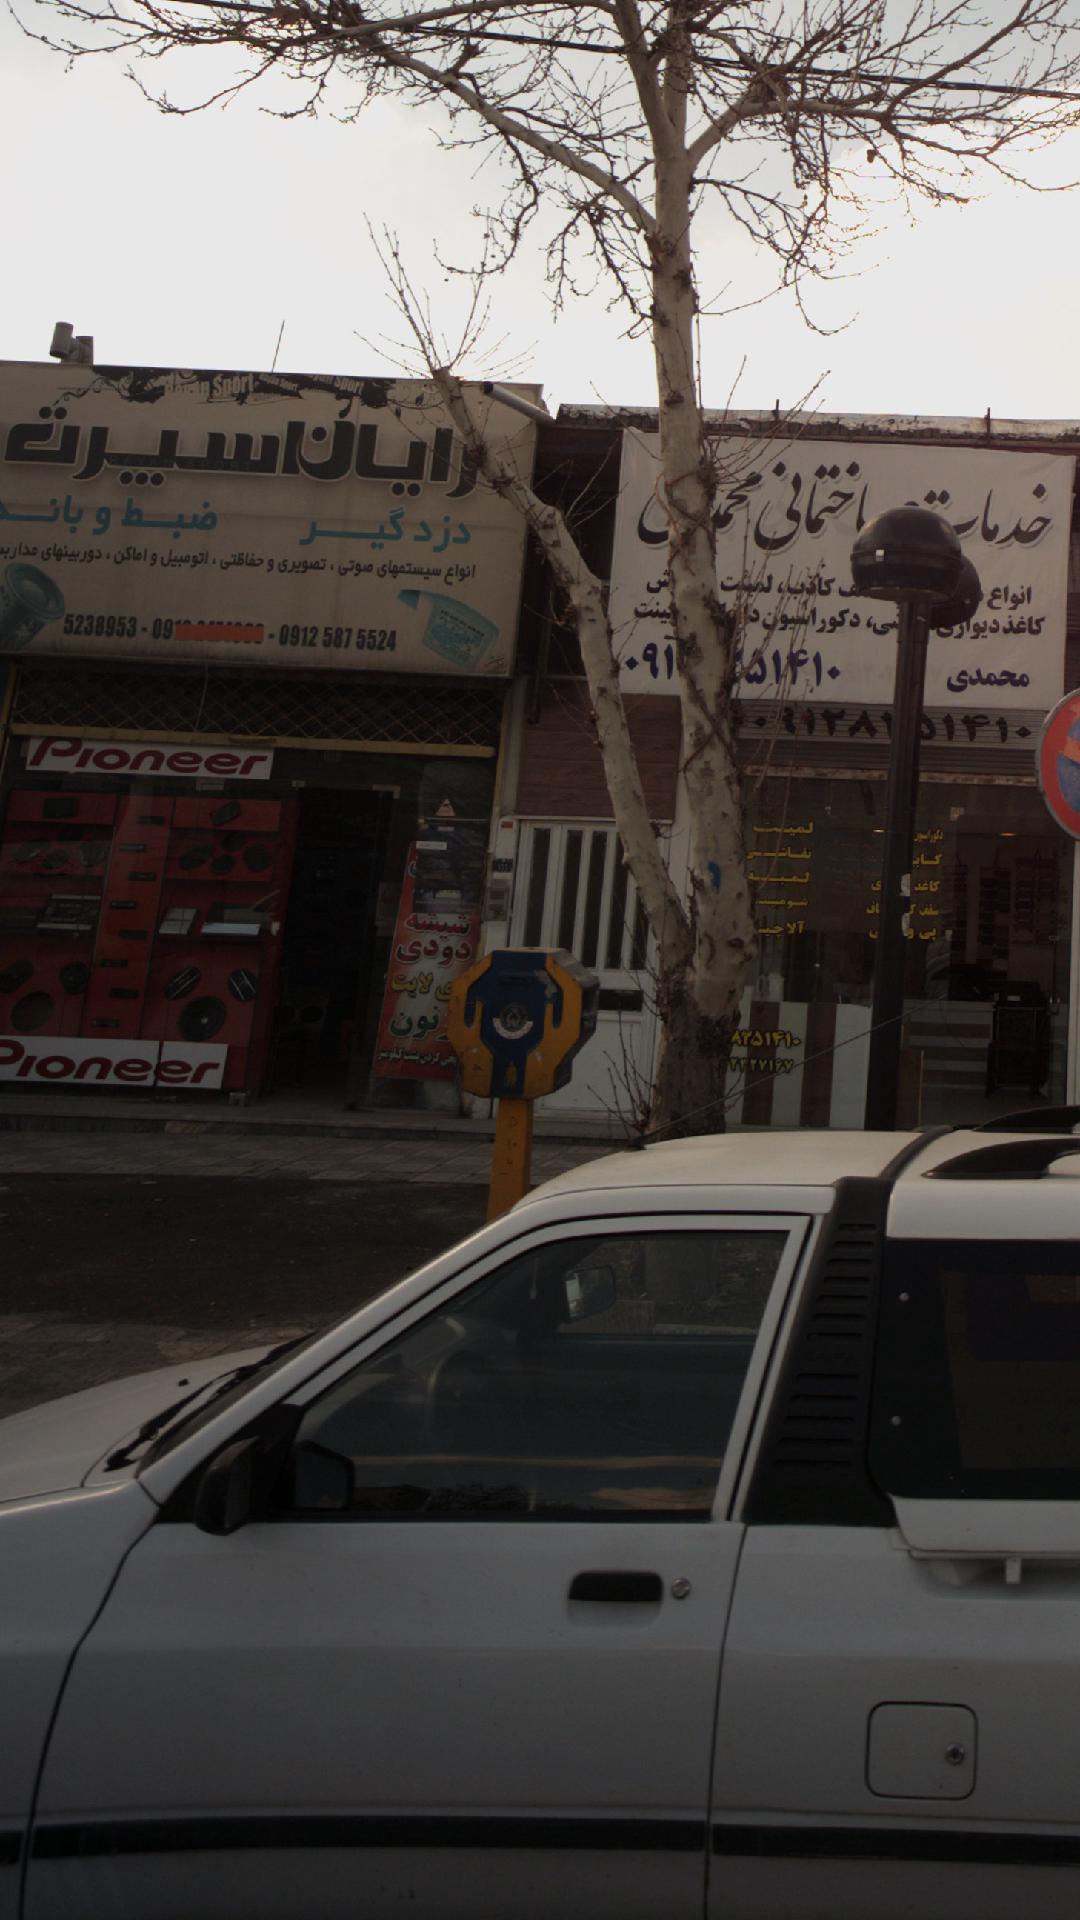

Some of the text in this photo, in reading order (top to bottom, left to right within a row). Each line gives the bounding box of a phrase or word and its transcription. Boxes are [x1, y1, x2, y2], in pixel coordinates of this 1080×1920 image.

[4, 406, 306, 486] اسپرت
[92, 505, 111, 536] و
[121, 496, 218, 539] ضبط
[444, 564, 476, 585] انواع
[986, 584, 1033, 611] انواع
[63, 613, 136, 637] 5238953
[278, 624, 317, 648] 0912
[322, 626, 352, 649] 587
[355, 628, 397, 652] 5524
[1002, 614, 1046, 636] کاغذ
[625, 642, 839, 688] ۰۹۱۵۱۴۱۰
[946, 667, 1030, 693] محمدی
[29, 735, 269, 776] Pioneer
[404, 912, 470, 938] شیشه
[396, 938, 471, 967] دودی
[0, 1038, 220, 1085] Pioneer
